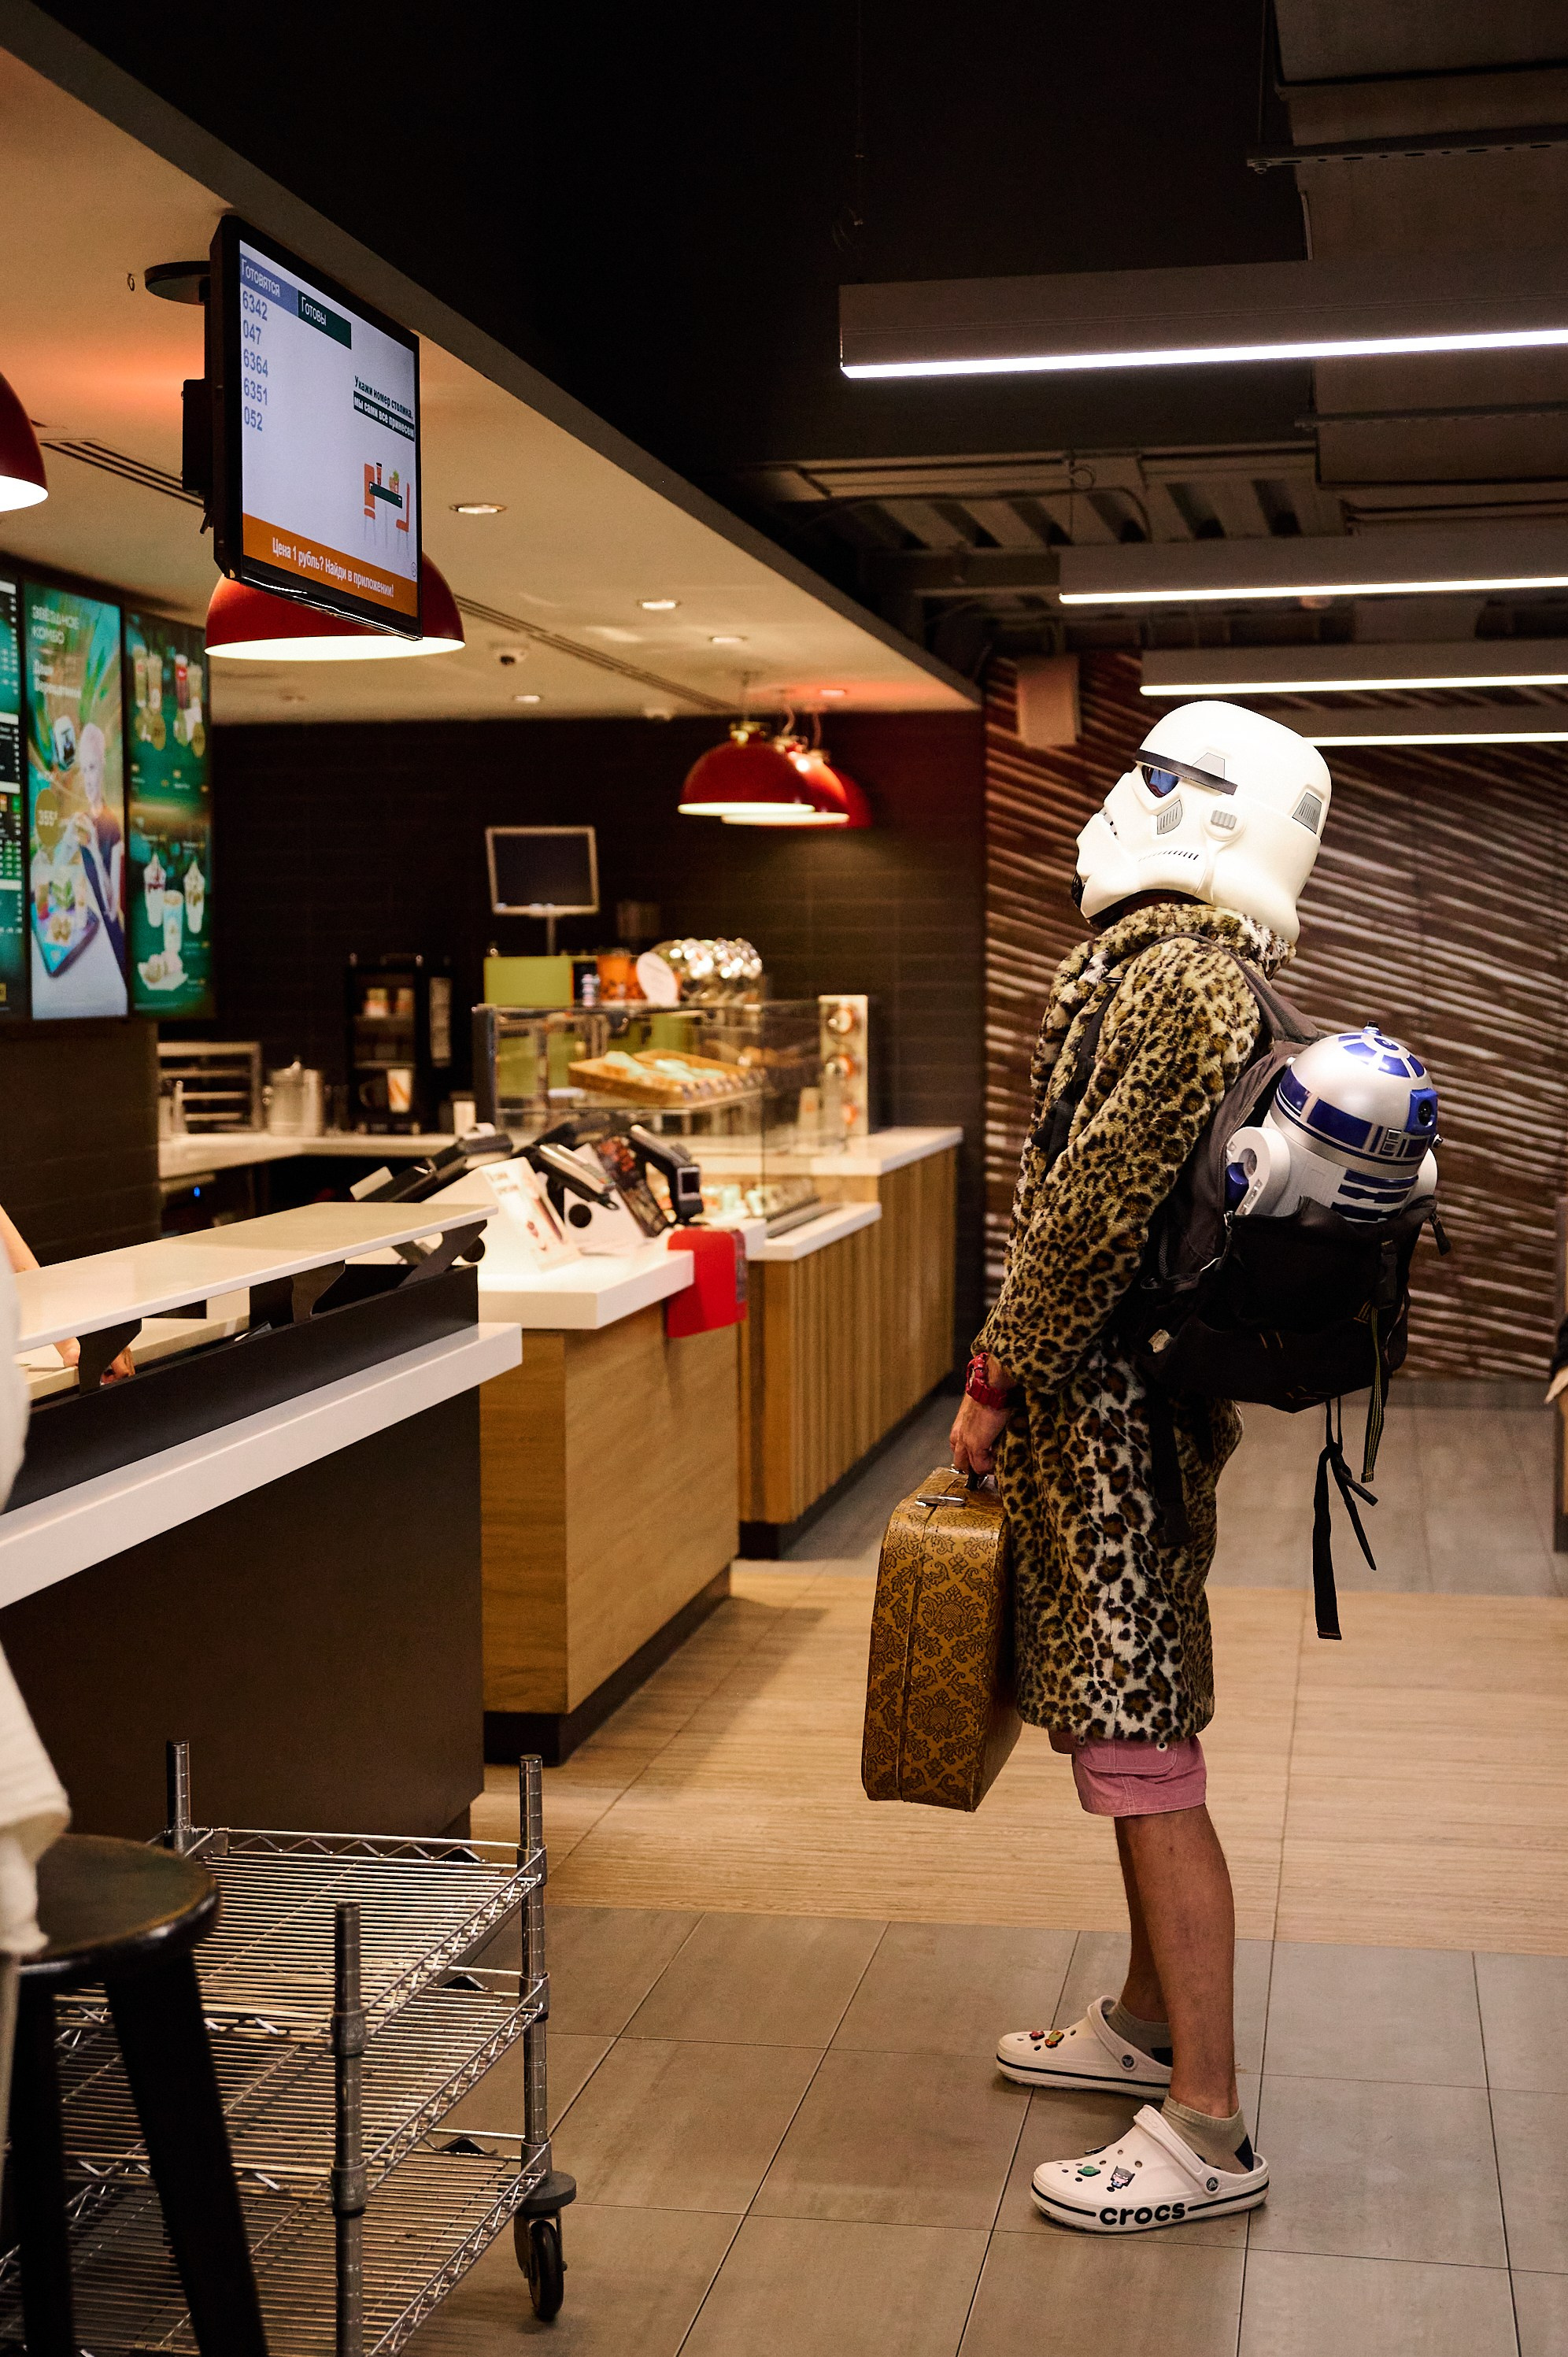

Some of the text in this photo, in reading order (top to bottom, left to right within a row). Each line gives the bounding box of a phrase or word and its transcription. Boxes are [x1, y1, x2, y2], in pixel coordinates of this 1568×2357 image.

[241, 258, 280, 298] Готовятся
[242, 290, 268, 321] 6342
[301, 296, 327, 326] Готовы
[242, 319, 261, 345] 047
[243, 349, 268, 377] 6364
[243, 377, 268, 405] 6351
[354, 375, 373, 397] Укажи
[373, 389, 390, 409] номер
[244, 405, 263, 431] 052
[272, 537, 394, 598] Цена 1 рубль? Найди в приложении!
[1099, 2202, 1185, 2226] crocs
